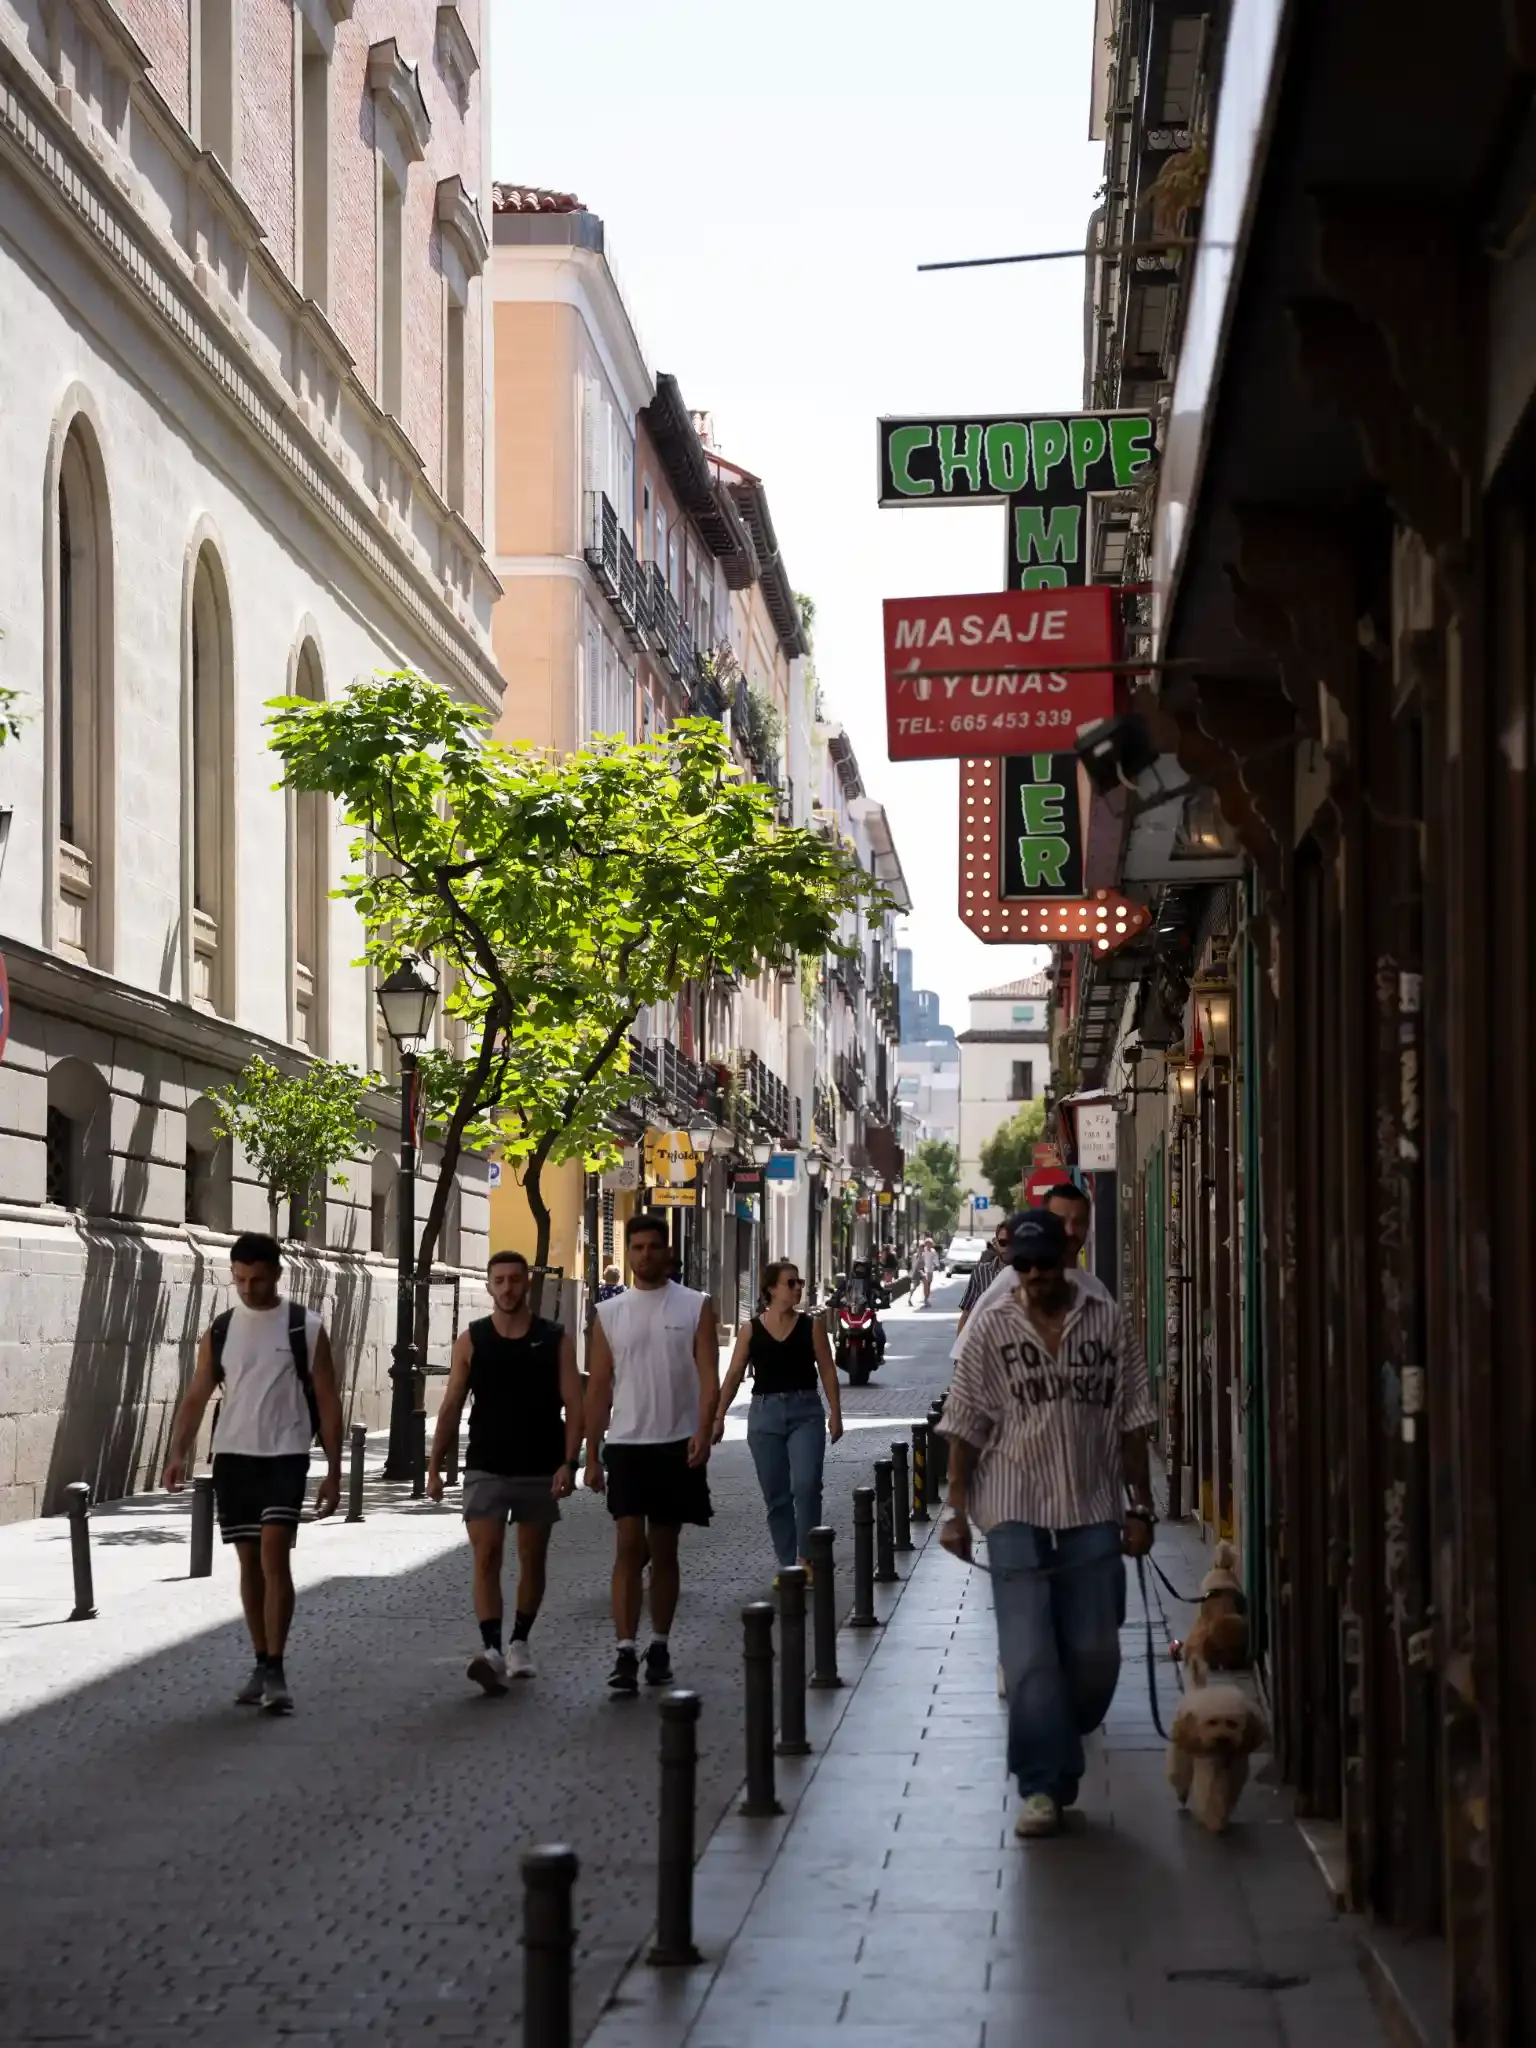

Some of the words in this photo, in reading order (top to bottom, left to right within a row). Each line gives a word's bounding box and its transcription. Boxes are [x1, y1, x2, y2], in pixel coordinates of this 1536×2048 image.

[895, 610, 1068, 649] MASAJE
[897, 717, 944, 734] TEL:
[992, 711, 1030, 729] 453
[1035, 709, 1072, 726] 339
